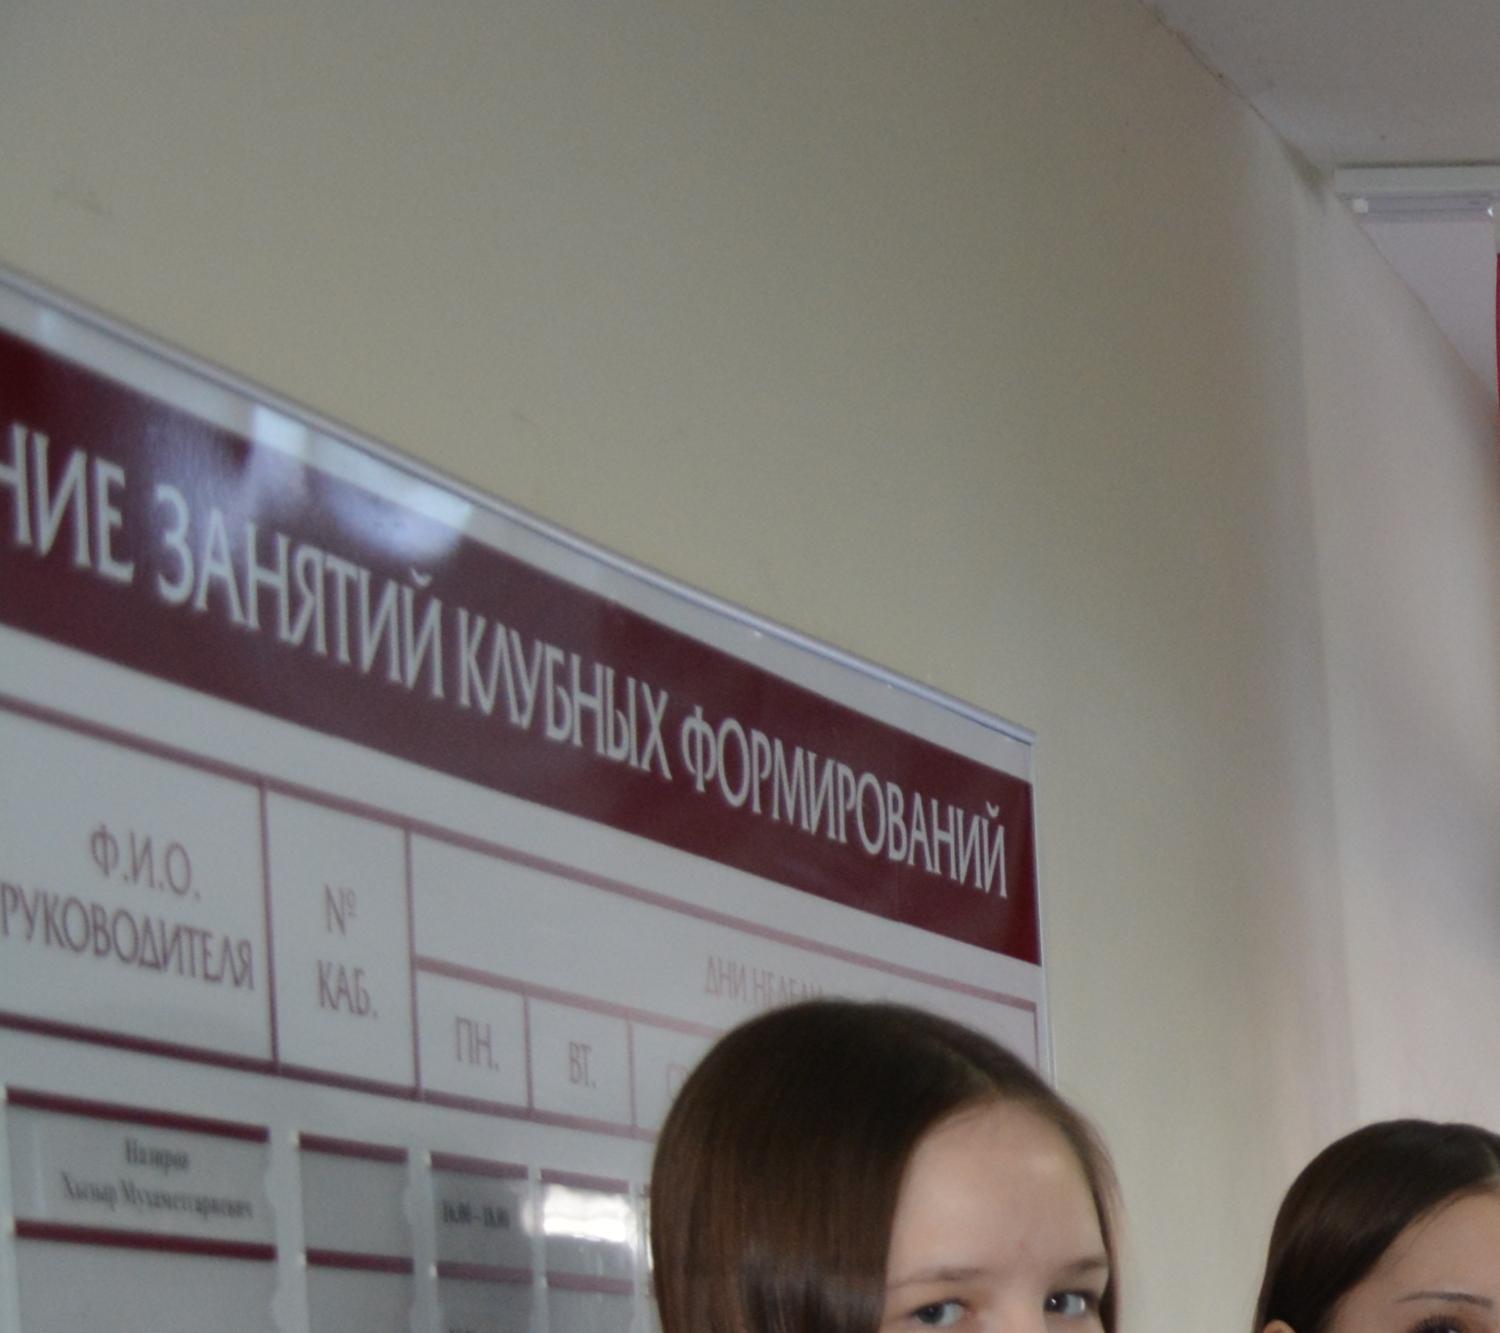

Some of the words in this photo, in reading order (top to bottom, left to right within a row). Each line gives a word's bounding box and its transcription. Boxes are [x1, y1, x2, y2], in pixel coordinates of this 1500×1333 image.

[155, 483, 446, 698] ЗАНЯТИЙ
[458, 606, 673, 781] КЛУБНЫХ
[680, 704, 1009, 899] ФОРМИРОВАНИЙ
[90, 823, 200, 901] Ф.И.О.
[0, 881, 256, 992] РУКОВОДИТЕЛЯ
[324, 883, 358, 936] №
[317, 958, 380, 1020] КАБ.
[705, 955, 748, 1003] ДНИ
[455, 1015, 499, 1071] ПН.
[569, 1039, 598, 1089] ВТ.
